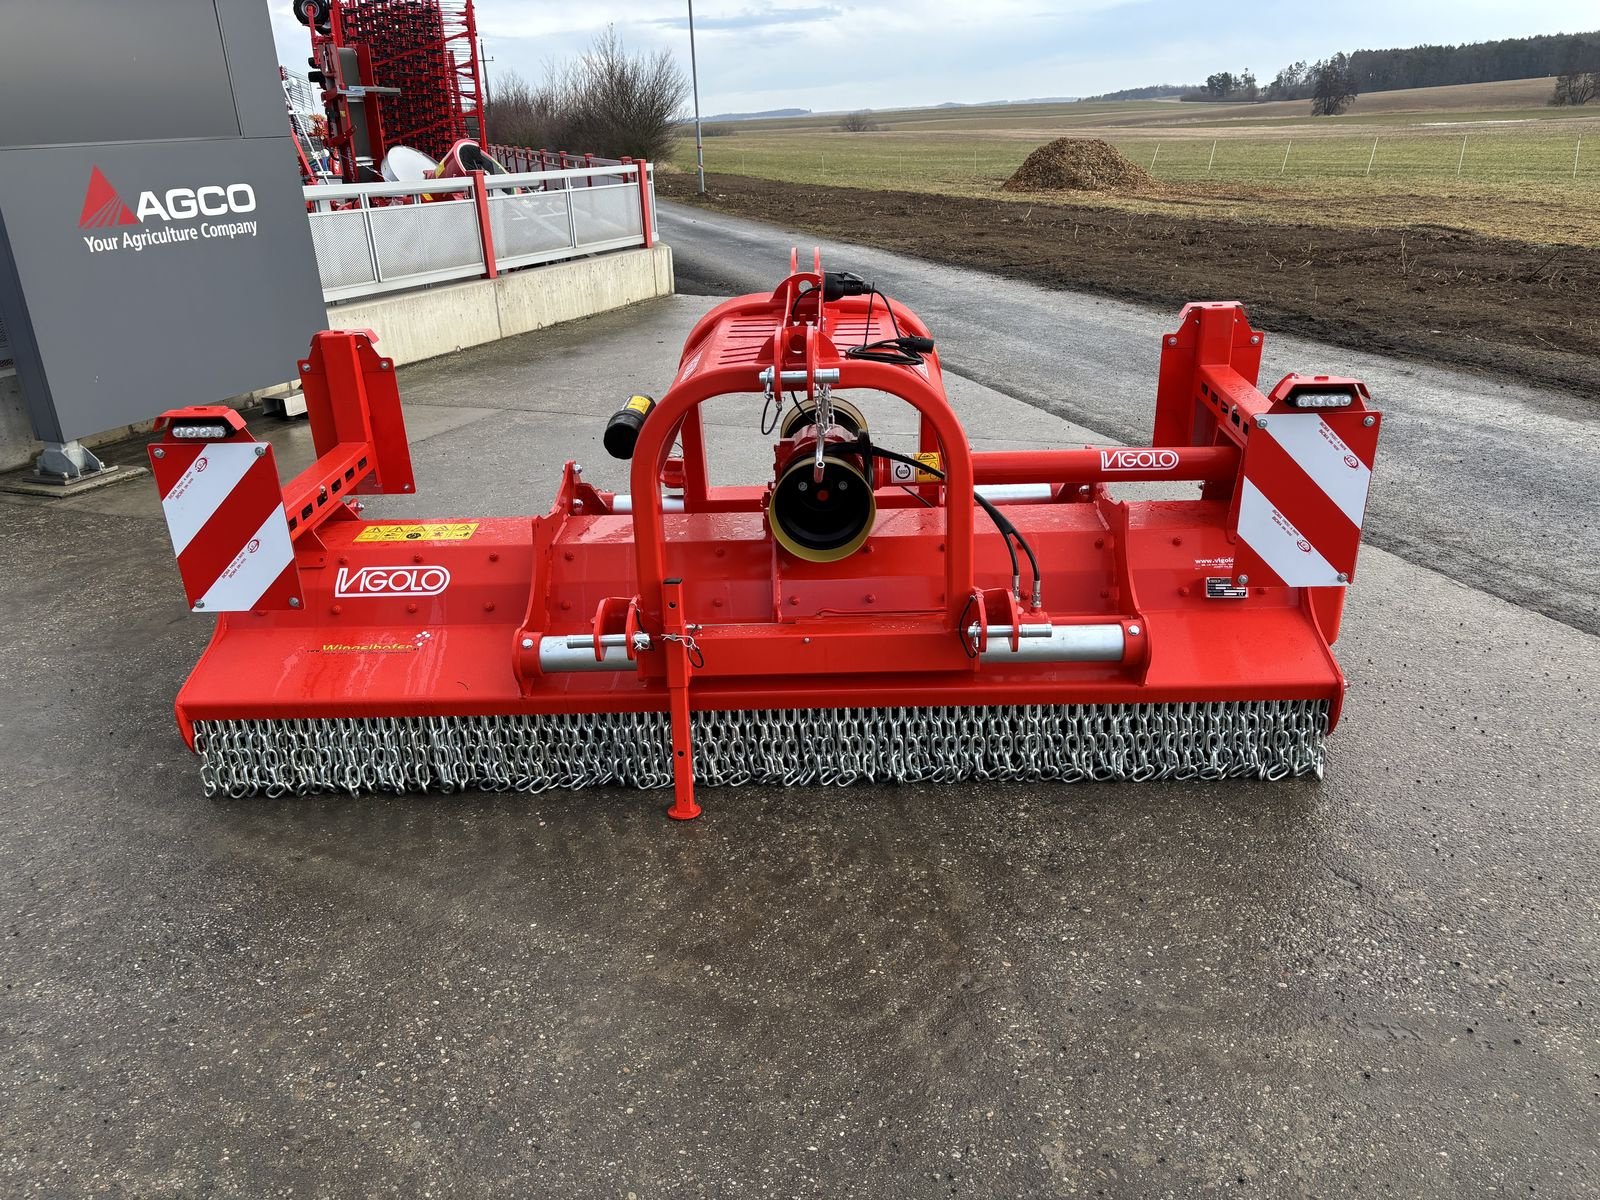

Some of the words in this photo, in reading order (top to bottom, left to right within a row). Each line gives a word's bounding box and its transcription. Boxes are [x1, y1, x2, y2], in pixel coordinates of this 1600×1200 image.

[136, 183, 256, 222] AGCO
[84, 236, 118, 253] Your
[122, 226, 198, 251] Agriculture
[201, 220, 257, 239] Company
[1100, 449, 1179, 471] VIGOLO
[335, 565, 450, 598] VIGOLO
